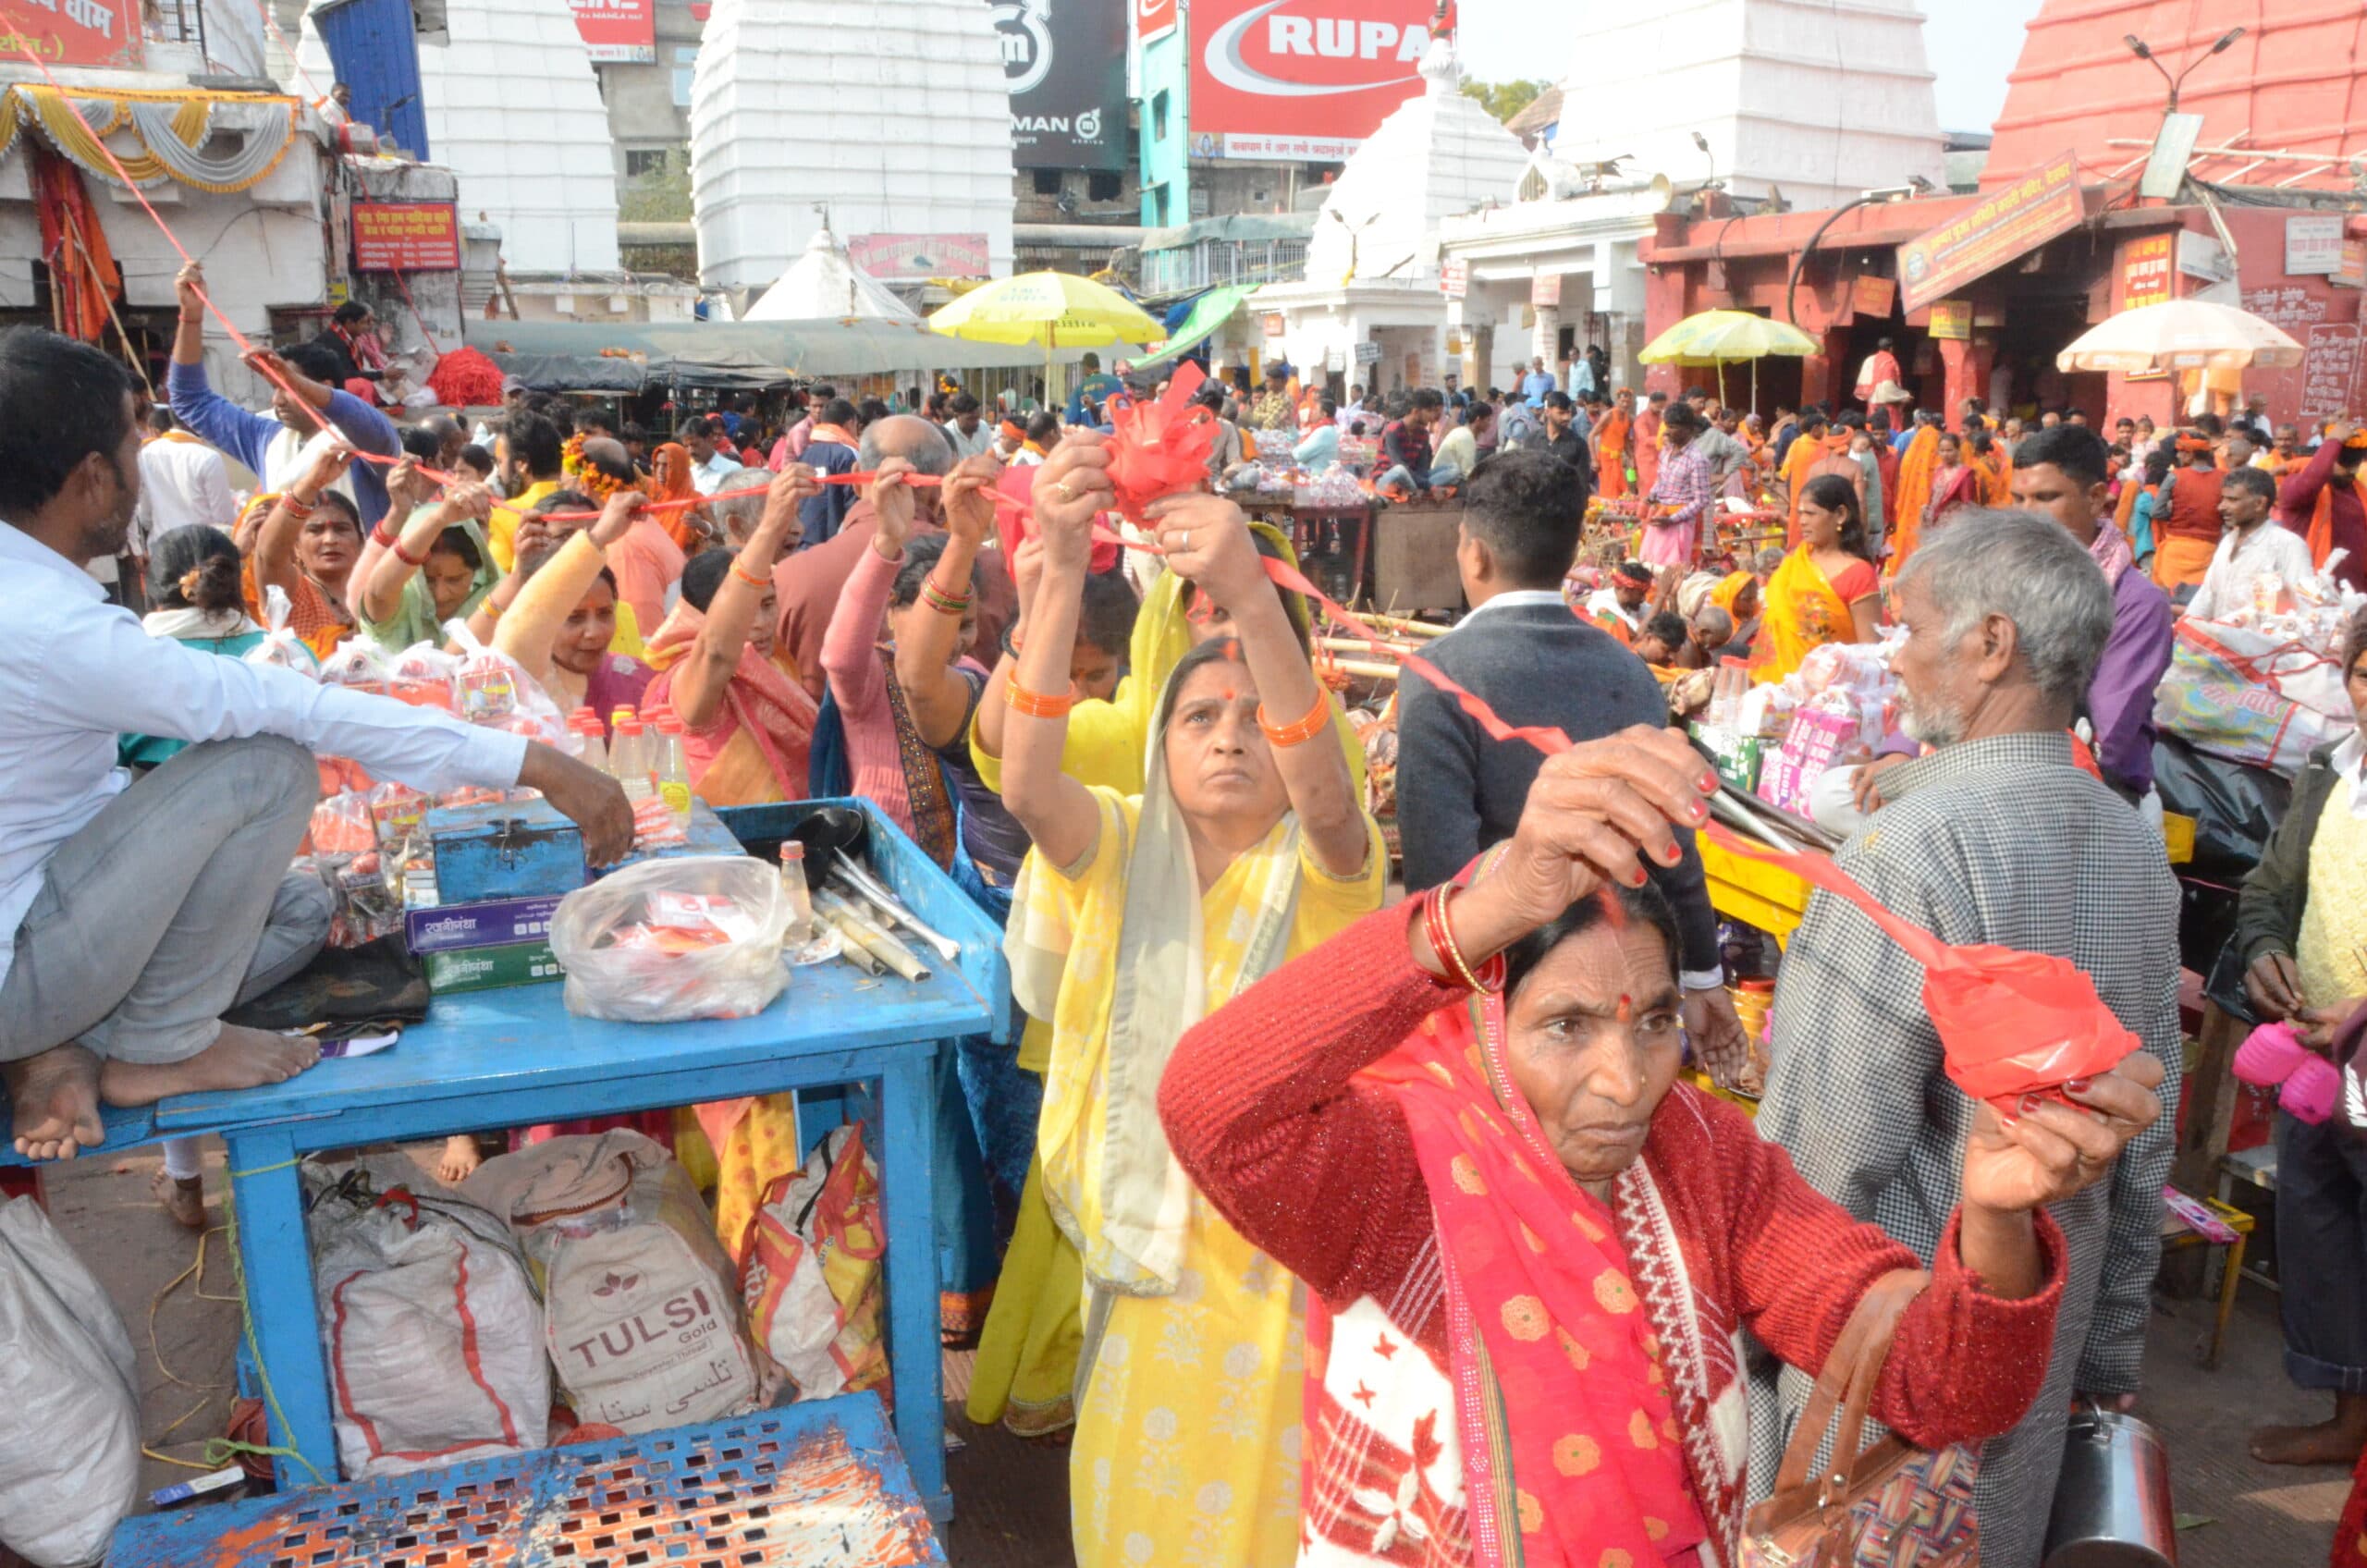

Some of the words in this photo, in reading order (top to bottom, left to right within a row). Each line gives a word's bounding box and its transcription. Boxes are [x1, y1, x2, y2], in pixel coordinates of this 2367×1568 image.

[1269, 15, 1432, 62] RUPA
[570, 1288, 711, 1368] TULSI
[679, 1318, 718, 1343] Gold
